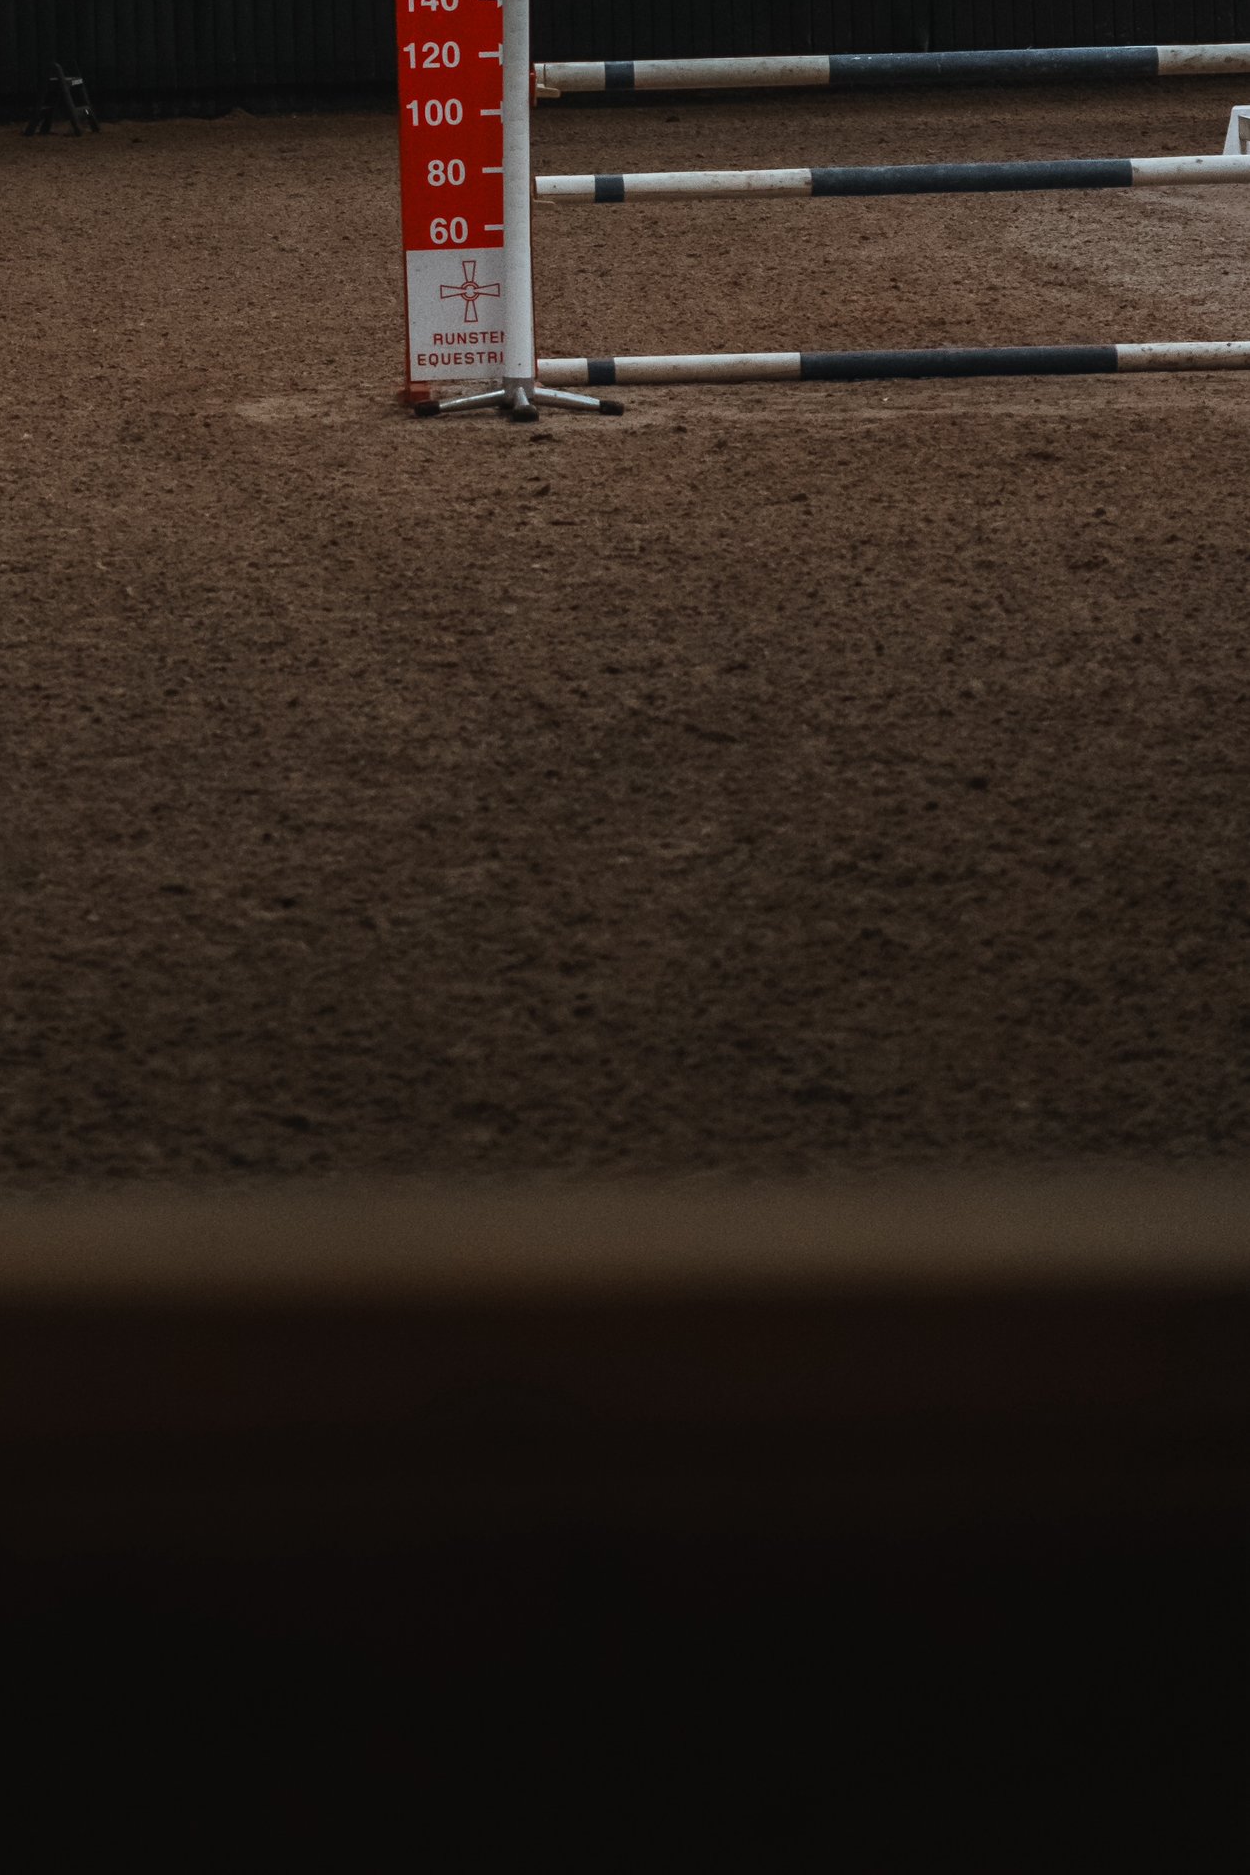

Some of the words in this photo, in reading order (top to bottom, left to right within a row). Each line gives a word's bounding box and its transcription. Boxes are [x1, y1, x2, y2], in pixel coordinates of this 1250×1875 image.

[404, 41, 460, 68] 120
[406, 99, 463, 126] 100
[427, 159, 465, 187] 80
[430, 217, 468, 244] 60
